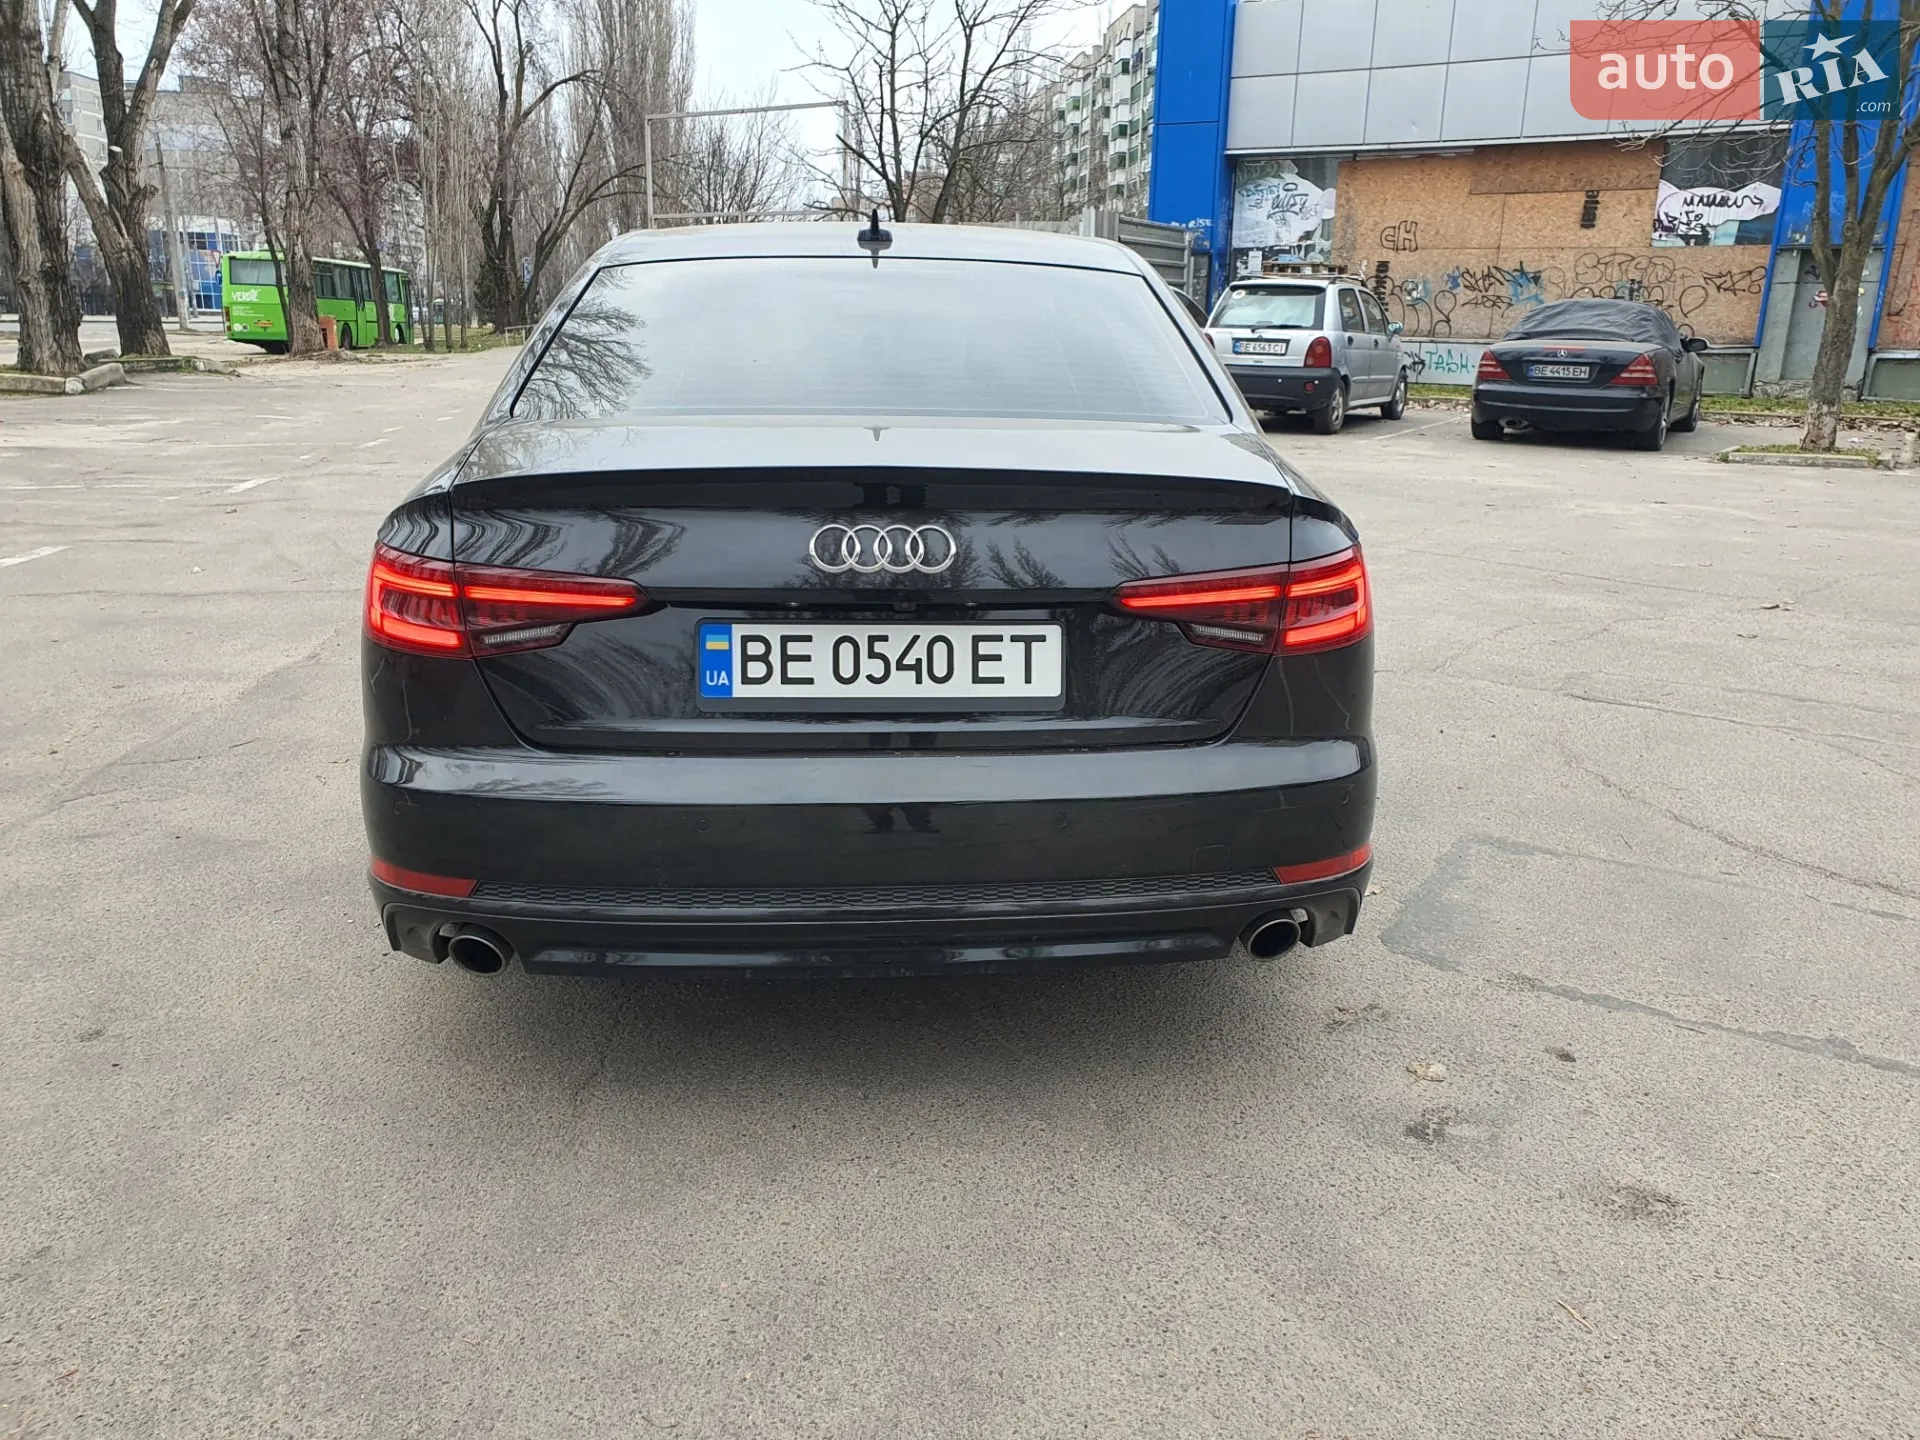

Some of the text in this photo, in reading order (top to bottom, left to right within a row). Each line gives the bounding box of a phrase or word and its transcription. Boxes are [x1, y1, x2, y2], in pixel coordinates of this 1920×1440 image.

[1534, 365, 1548, 376] BE
[740, 634, 1047, 686] BE 0540 ET
[705, 670, 730, 686] UA
